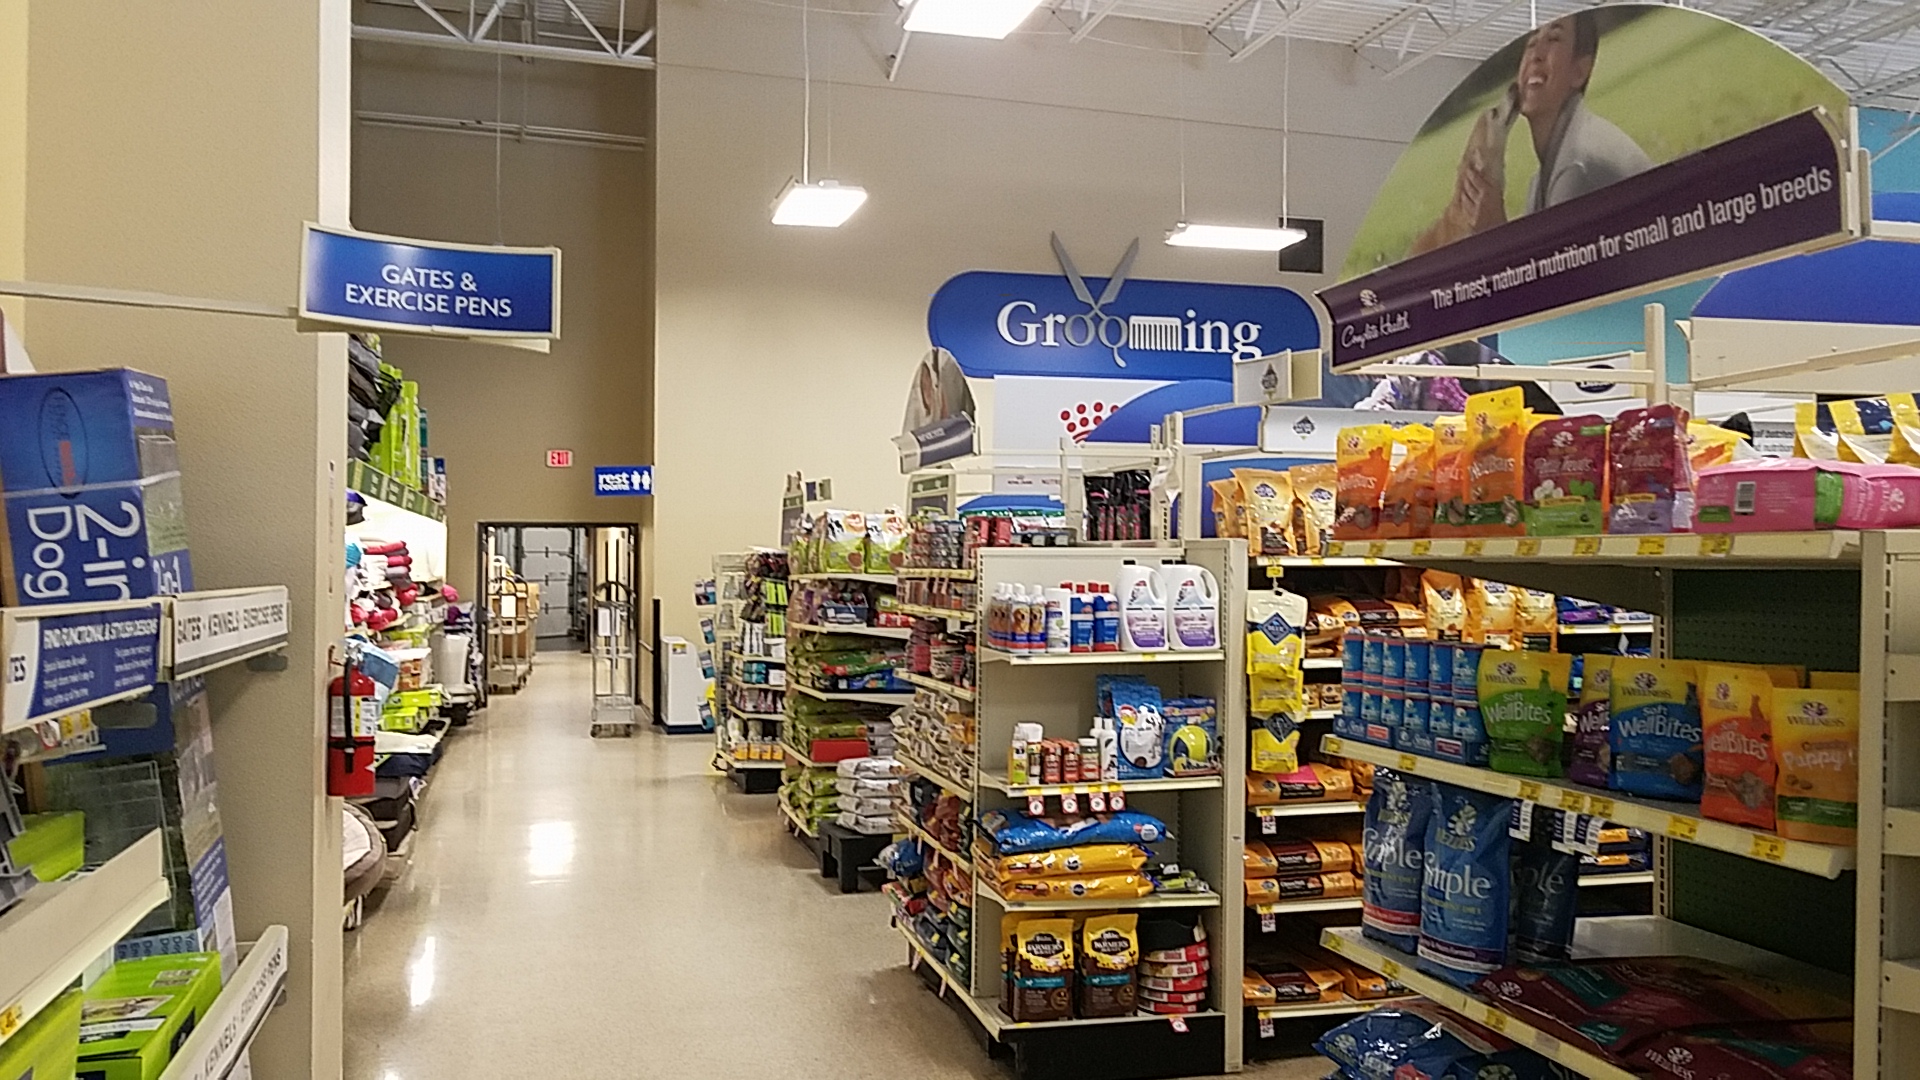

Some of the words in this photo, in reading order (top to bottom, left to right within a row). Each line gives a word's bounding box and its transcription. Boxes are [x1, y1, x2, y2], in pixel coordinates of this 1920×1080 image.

[1431, 288, 1454, 311] The
[1454, 273, 1494, 306] finest,
[1493, 258, 1538, 293] natural
[1538, 242, 1598, 280] nutrition
[1599, 233, 1622, 259] for
[1623, 217, 1670, 253] small
[1672, 203, 1706, 241] and
[1708, 188, 1757, 229] large
[1759, 165, 1833, 212] breeds
[381, 262, 455, 291] GATES
[460, 273, 478, 292] &
[345, 284, 450, 315] EXERCISE
[455, 296, 513, 319] PENS
[551, 451, 570, 466] EXIT
[598, 471, 630, 486] rest
[23, 505, 74, 600] Dog
[1485, 701, 1553, 726] WellBites
[1617, 714, 1703, 743] WellBites
